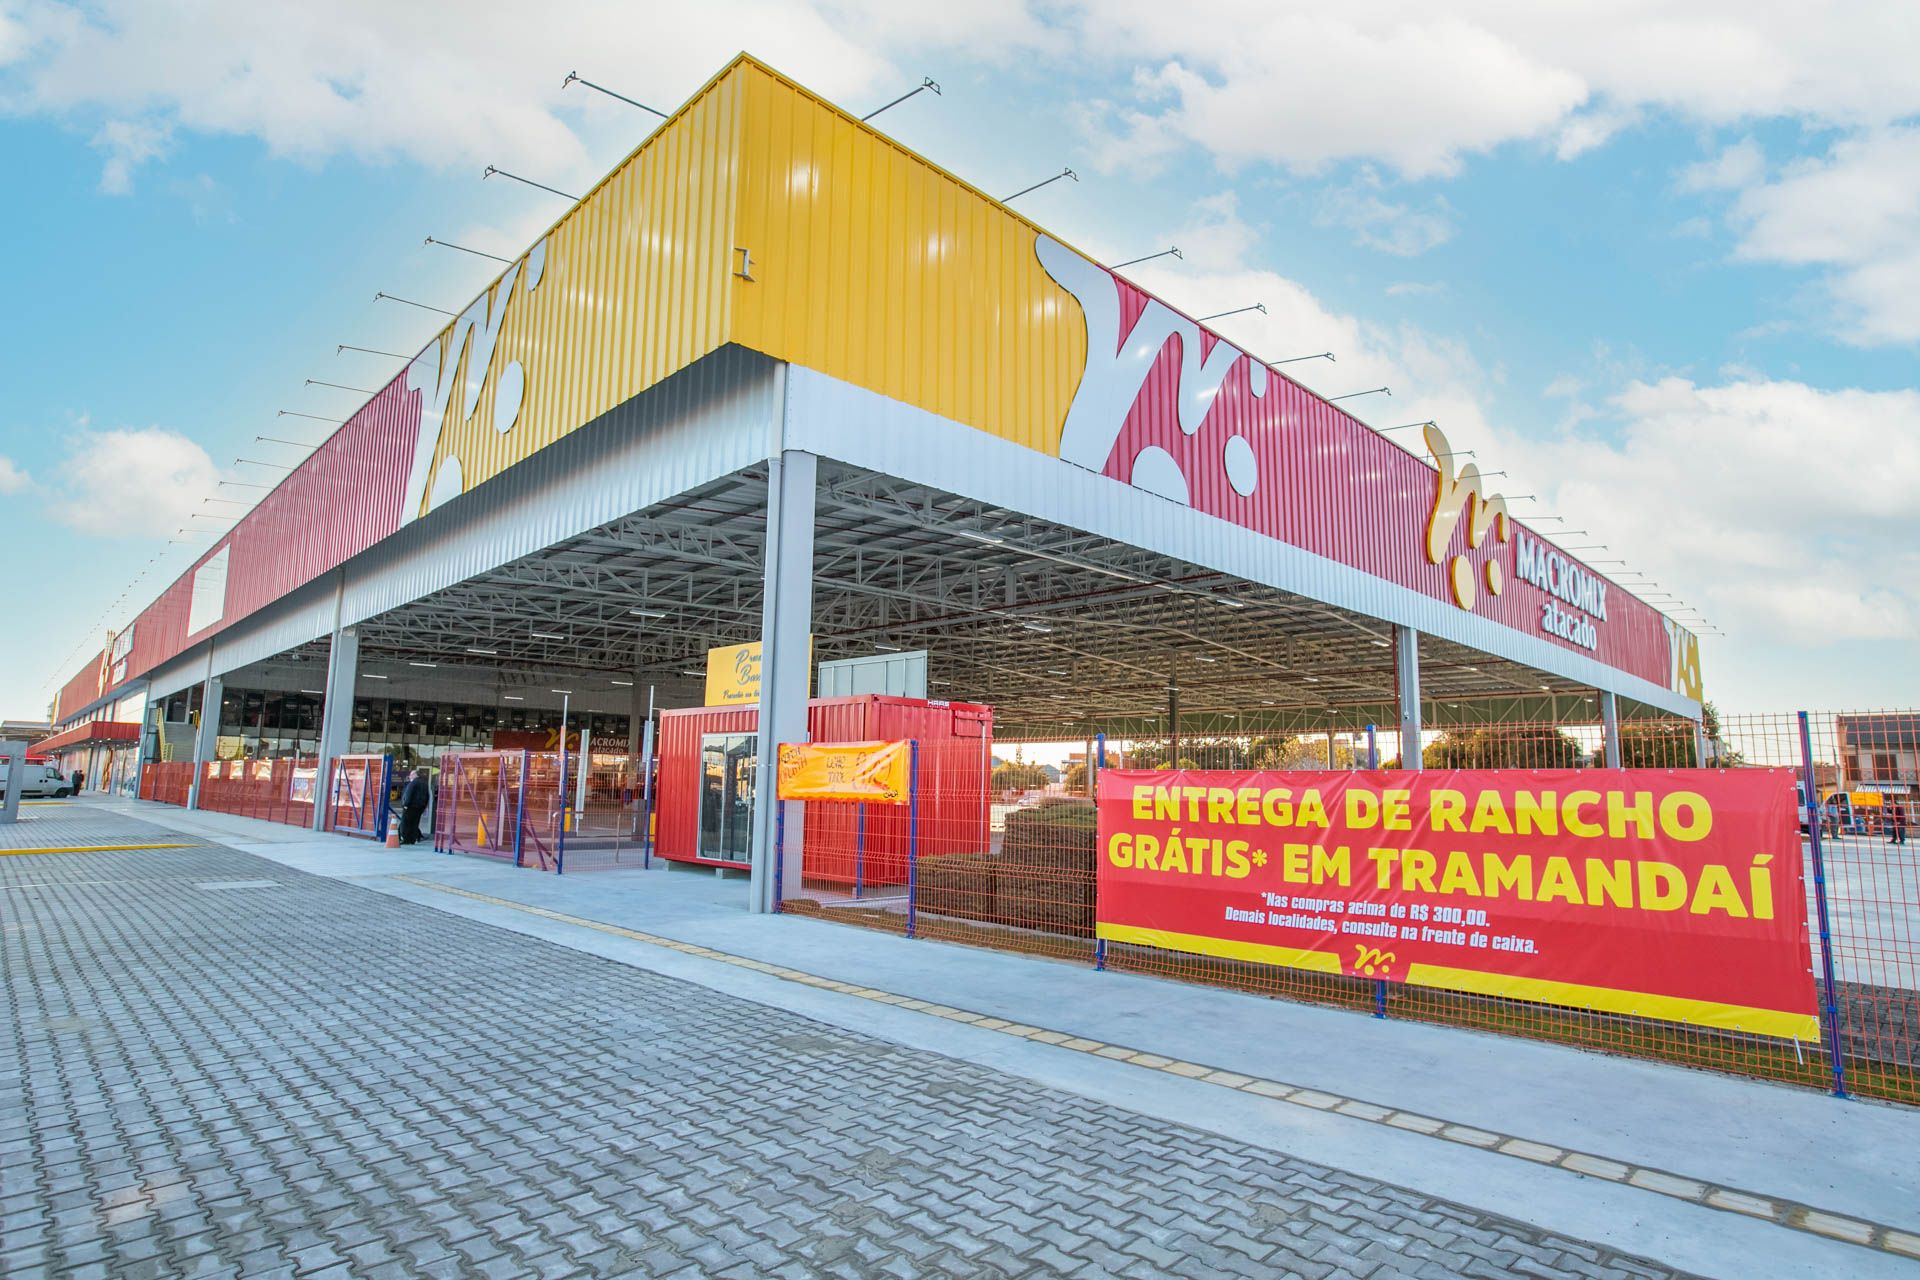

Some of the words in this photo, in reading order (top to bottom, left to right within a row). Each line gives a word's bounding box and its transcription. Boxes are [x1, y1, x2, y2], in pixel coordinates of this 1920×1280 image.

[1516, 531, 1607, 622] MACROMIX
[1541, 599, 1597, 651] atacado
[590, 737, 631, 748] ACROMIX
[1132, 785, 1330, 828] ENTREGA
[1345, 788, 1413, 831] DE
[1430, 788, 1713, 842] RANCHO
[1283, 843, 1351, 887] EM
[1367, 847, 1775, 920] TRAMANDAÍ
[1225, 906, 1265, 924] Demais
[1268, 911, 1338, 934] localidades,
[1342, 920, 1397, 938] consulte
[1401, 927, 1418, 941] na
[1422, 926, 1466, 946] frente
[1470, 931, 1488, 948] de
[1492, 935, 1539, 954] caixa.
[1291, 896, 1344, 913] compras
[1348, 901, 1386, 916] acima
[1390, 903, 1406, 919] de
[1410, 904, 1429, 922] R$
[1433, 906, 1490, 927] 300,00.
